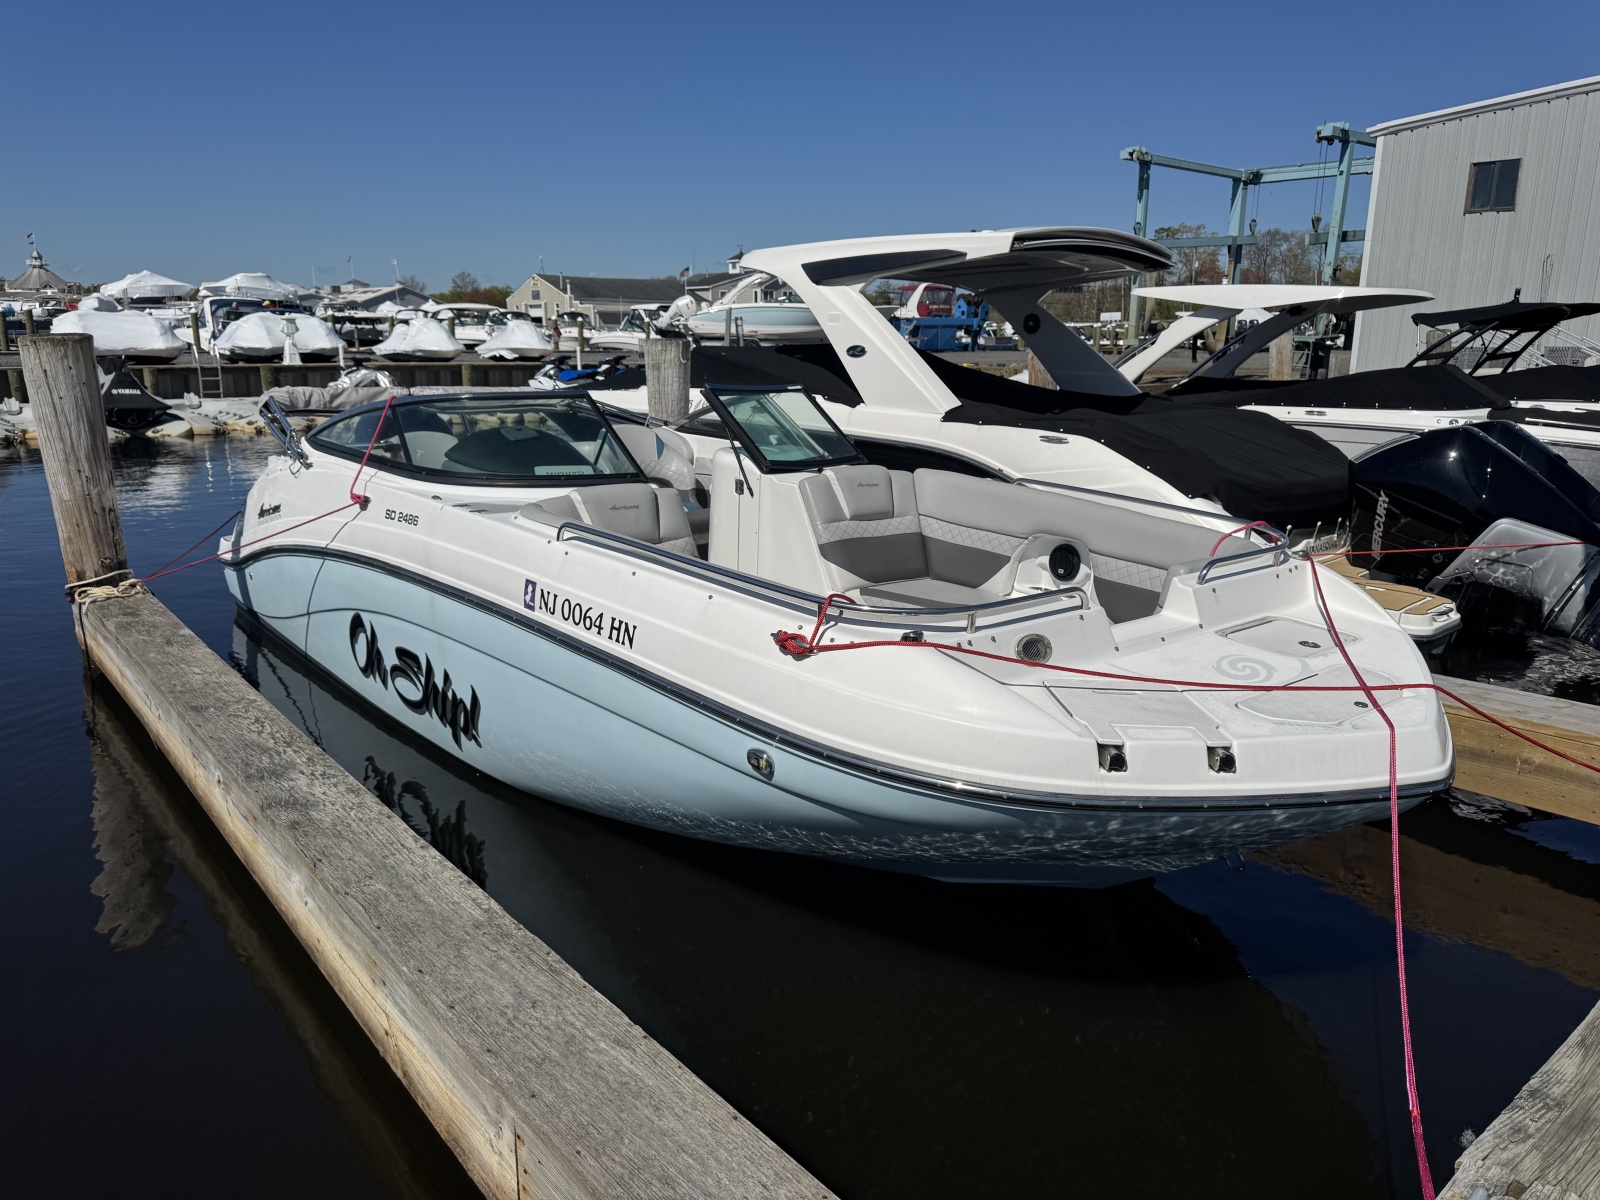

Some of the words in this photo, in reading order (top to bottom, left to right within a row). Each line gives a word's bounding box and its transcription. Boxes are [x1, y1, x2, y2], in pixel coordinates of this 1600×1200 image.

[384, 508, 397, 521] SD
[397, 511, 420, 527] 2486
[1370, 489, 1390, 561] MERCURY
[538, 588, 559, 616] NJ
[561, 598, 604, 637] 0064
[607, 616, 638, 650] HN
